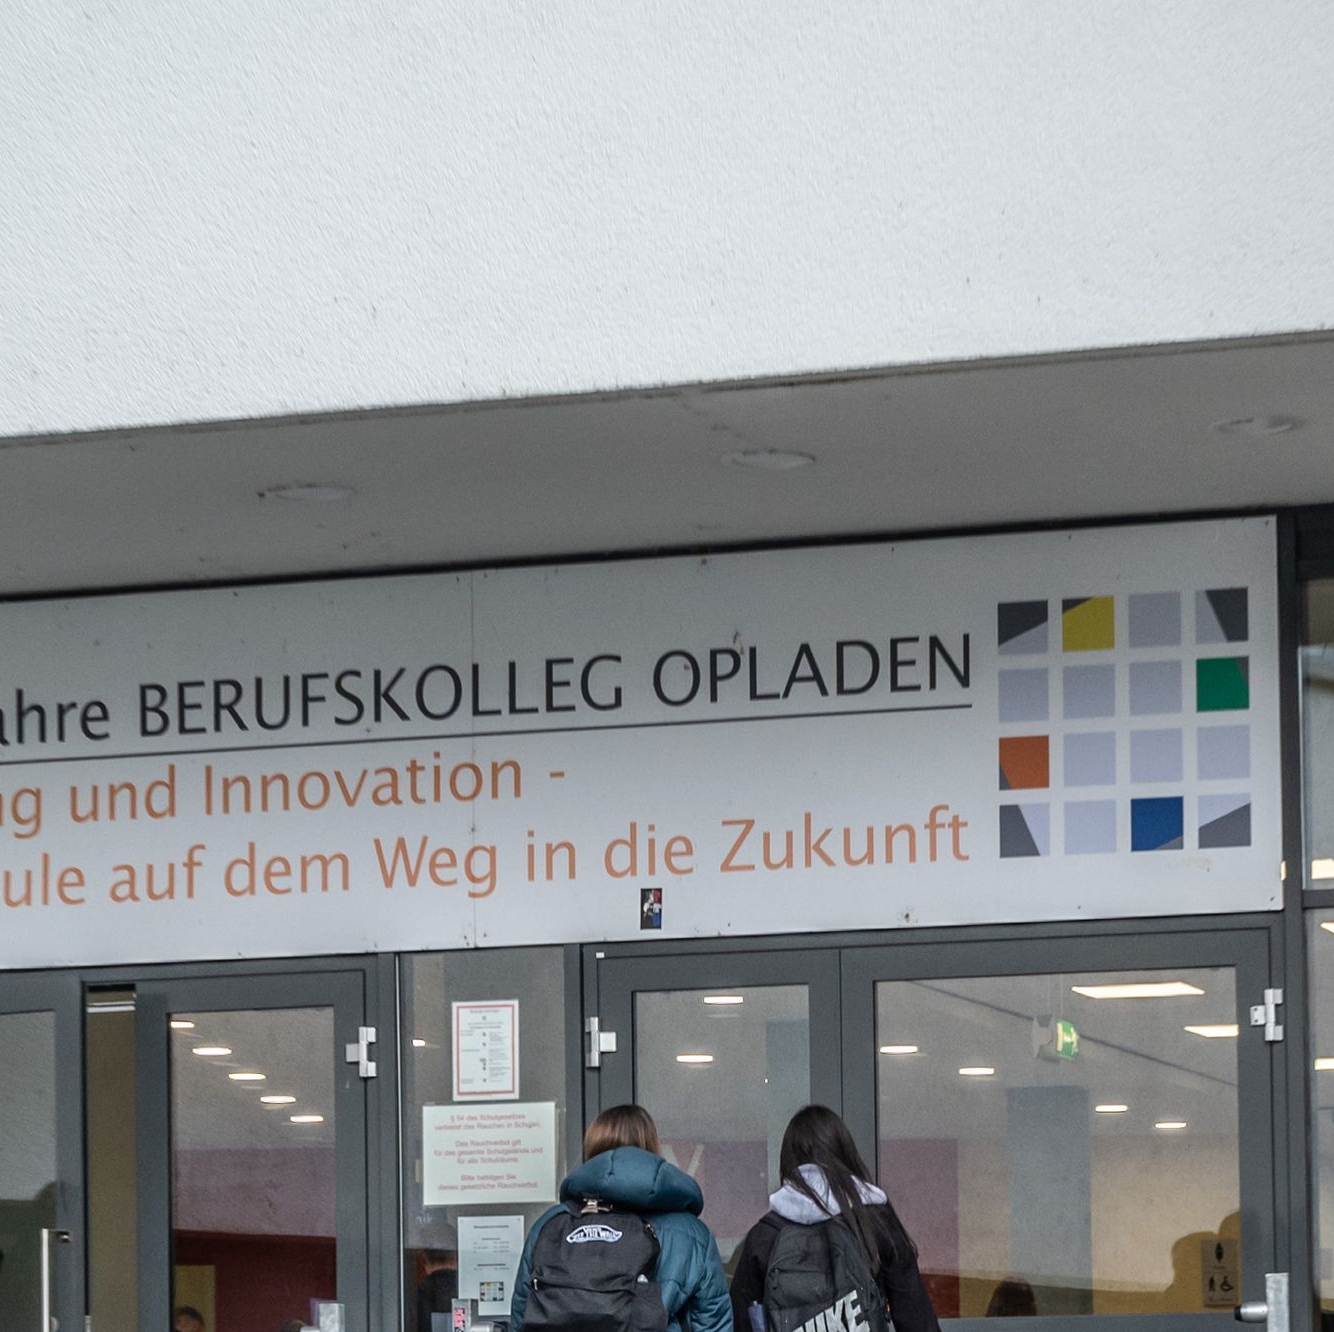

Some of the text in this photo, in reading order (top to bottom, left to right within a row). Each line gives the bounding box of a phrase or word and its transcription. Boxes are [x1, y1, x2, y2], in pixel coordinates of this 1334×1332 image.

[139, 654, 623, 738] BERUFSKOLLEG
[653, 633, 971, 707] OPLADEN
[70, 764, 176, 824] und
[204, 752, 522, 816] Innovation
[109, 844, 205, 903] auf
[223, 842, 350, 897] dem
[373, 836, 497, 899] Weg
[527, 832, 576, 881] in
[603, 822, 694, 879] die
[719, 804, 969, 873] Zukunft
